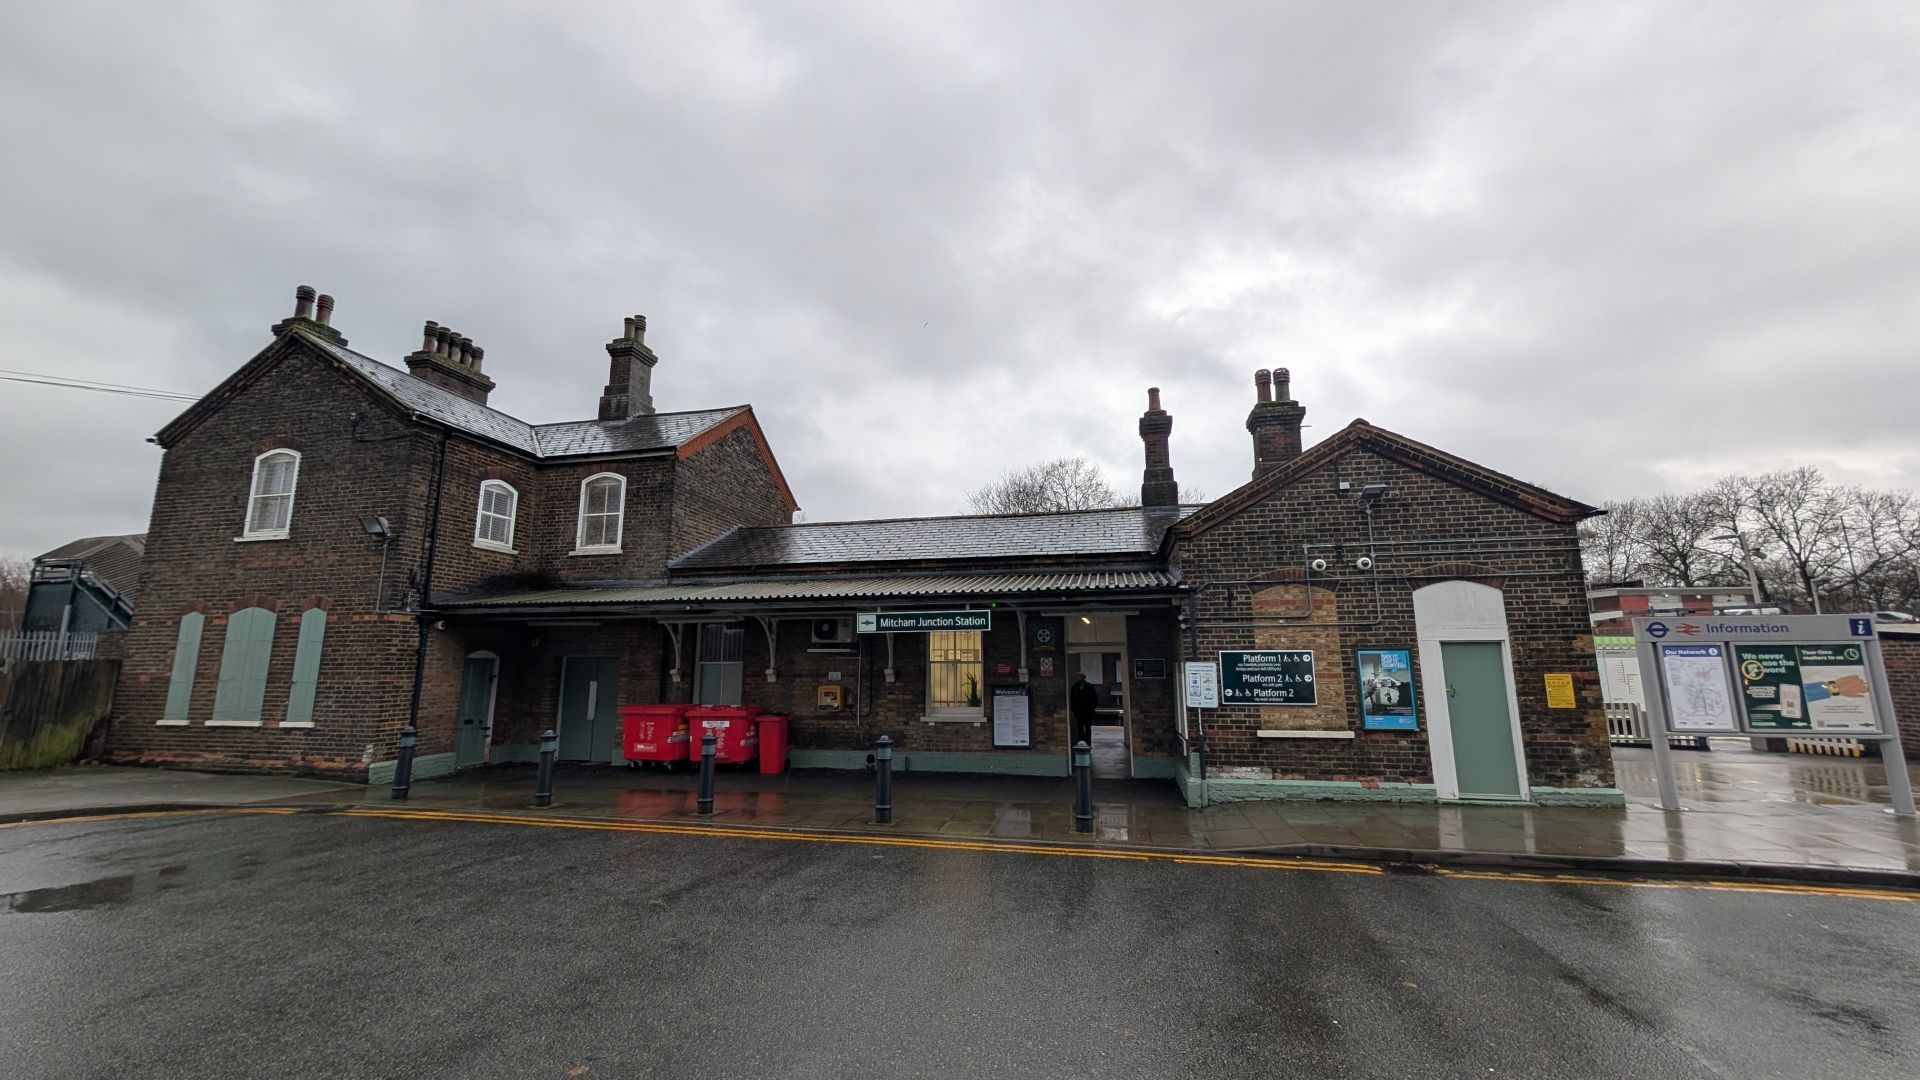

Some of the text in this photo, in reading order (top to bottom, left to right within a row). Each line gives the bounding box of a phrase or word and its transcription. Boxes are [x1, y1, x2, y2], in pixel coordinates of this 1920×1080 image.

[880, 615, 986, 628] Mitcham Junction Station
[1706, 623, 1789, 634] Information
[1243, 654, 1276, 663] Platform
[1242, 674, 1283, 683] Platform 2
[1253, 689, 1294, 698] Platform 2
